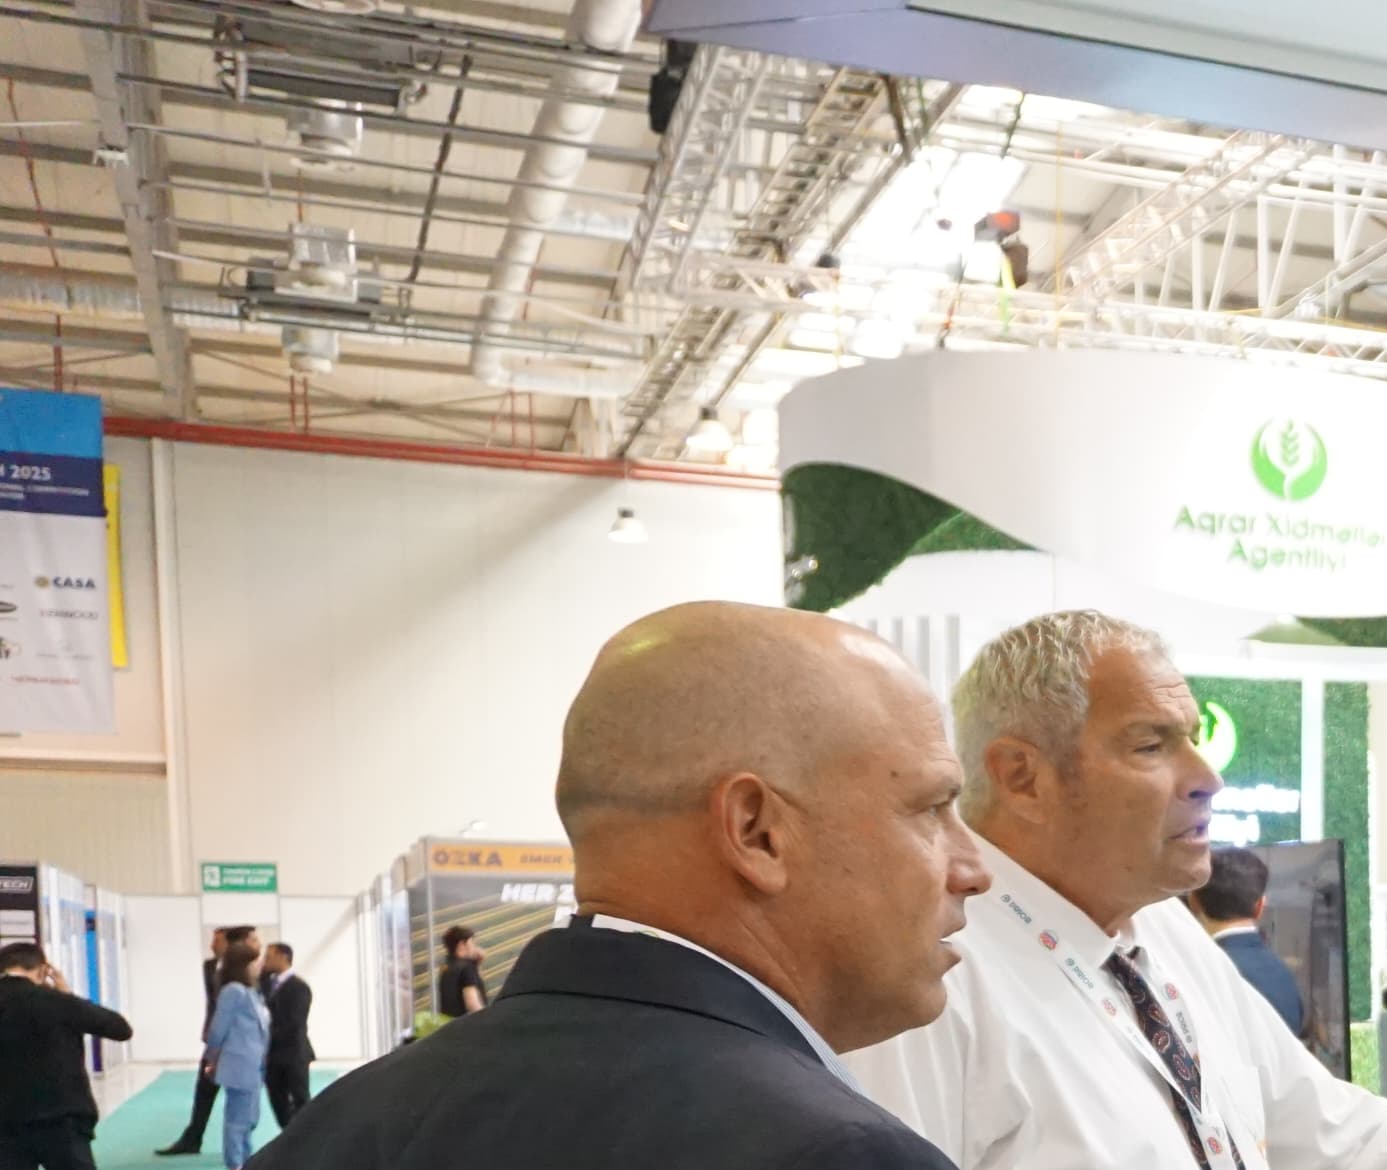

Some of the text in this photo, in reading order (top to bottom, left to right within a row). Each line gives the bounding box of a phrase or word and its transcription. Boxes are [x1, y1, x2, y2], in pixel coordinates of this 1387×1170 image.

[9, 465, 52, 480] 2025
[1174, 504, 1256, 536] Aqrar
[53, 576, 95, 590] CASA
